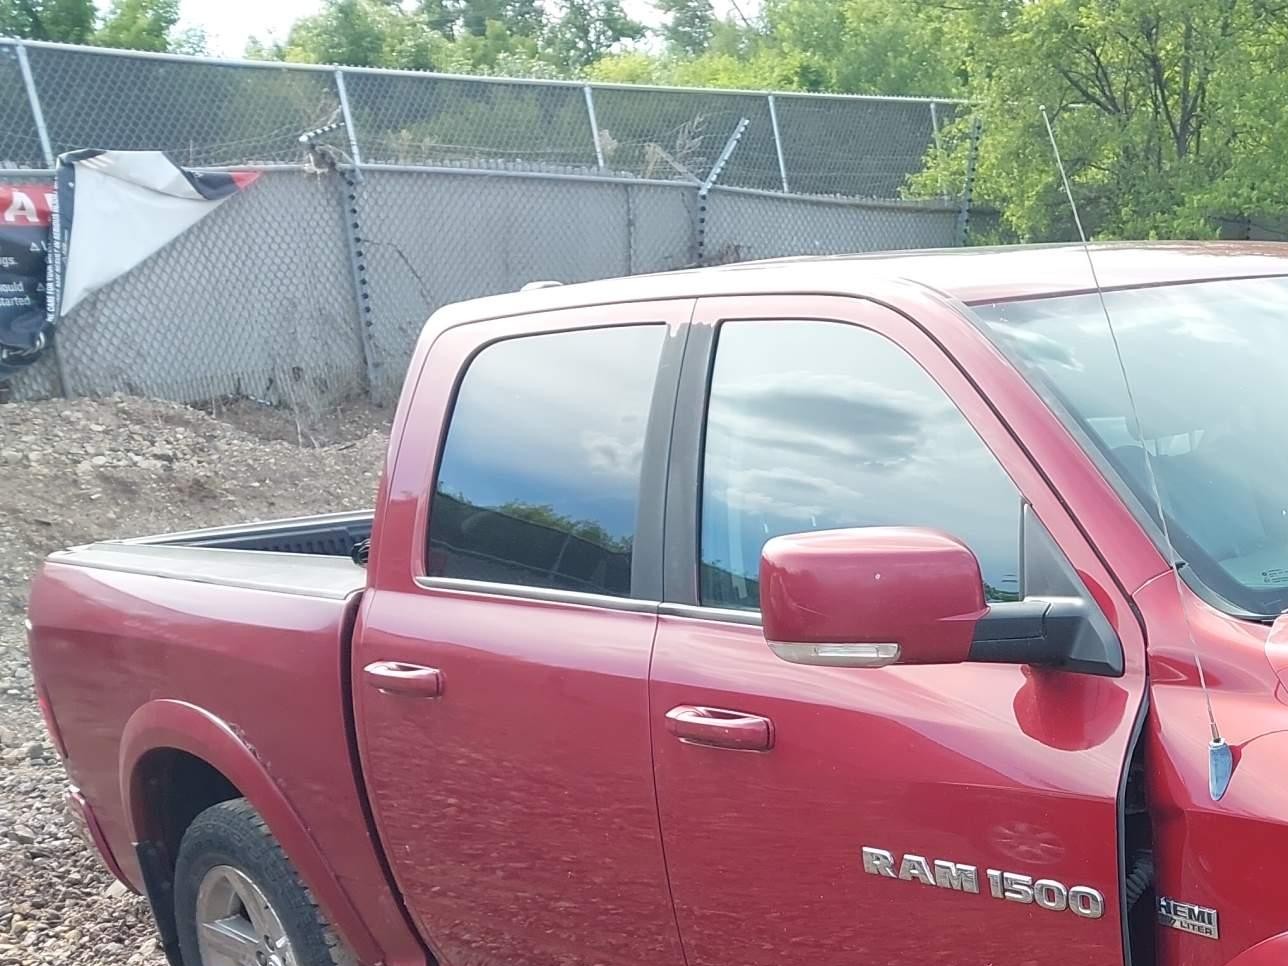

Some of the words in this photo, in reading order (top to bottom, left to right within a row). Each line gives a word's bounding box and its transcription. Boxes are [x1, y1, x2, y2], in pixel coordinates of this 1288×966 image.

[862, 846, 979, 893] RAM
[986, 868, 1104, 919] 1500
[1157, 896, 1213, 925] HEMI
[1180, 920, 1213, 935] LITER
